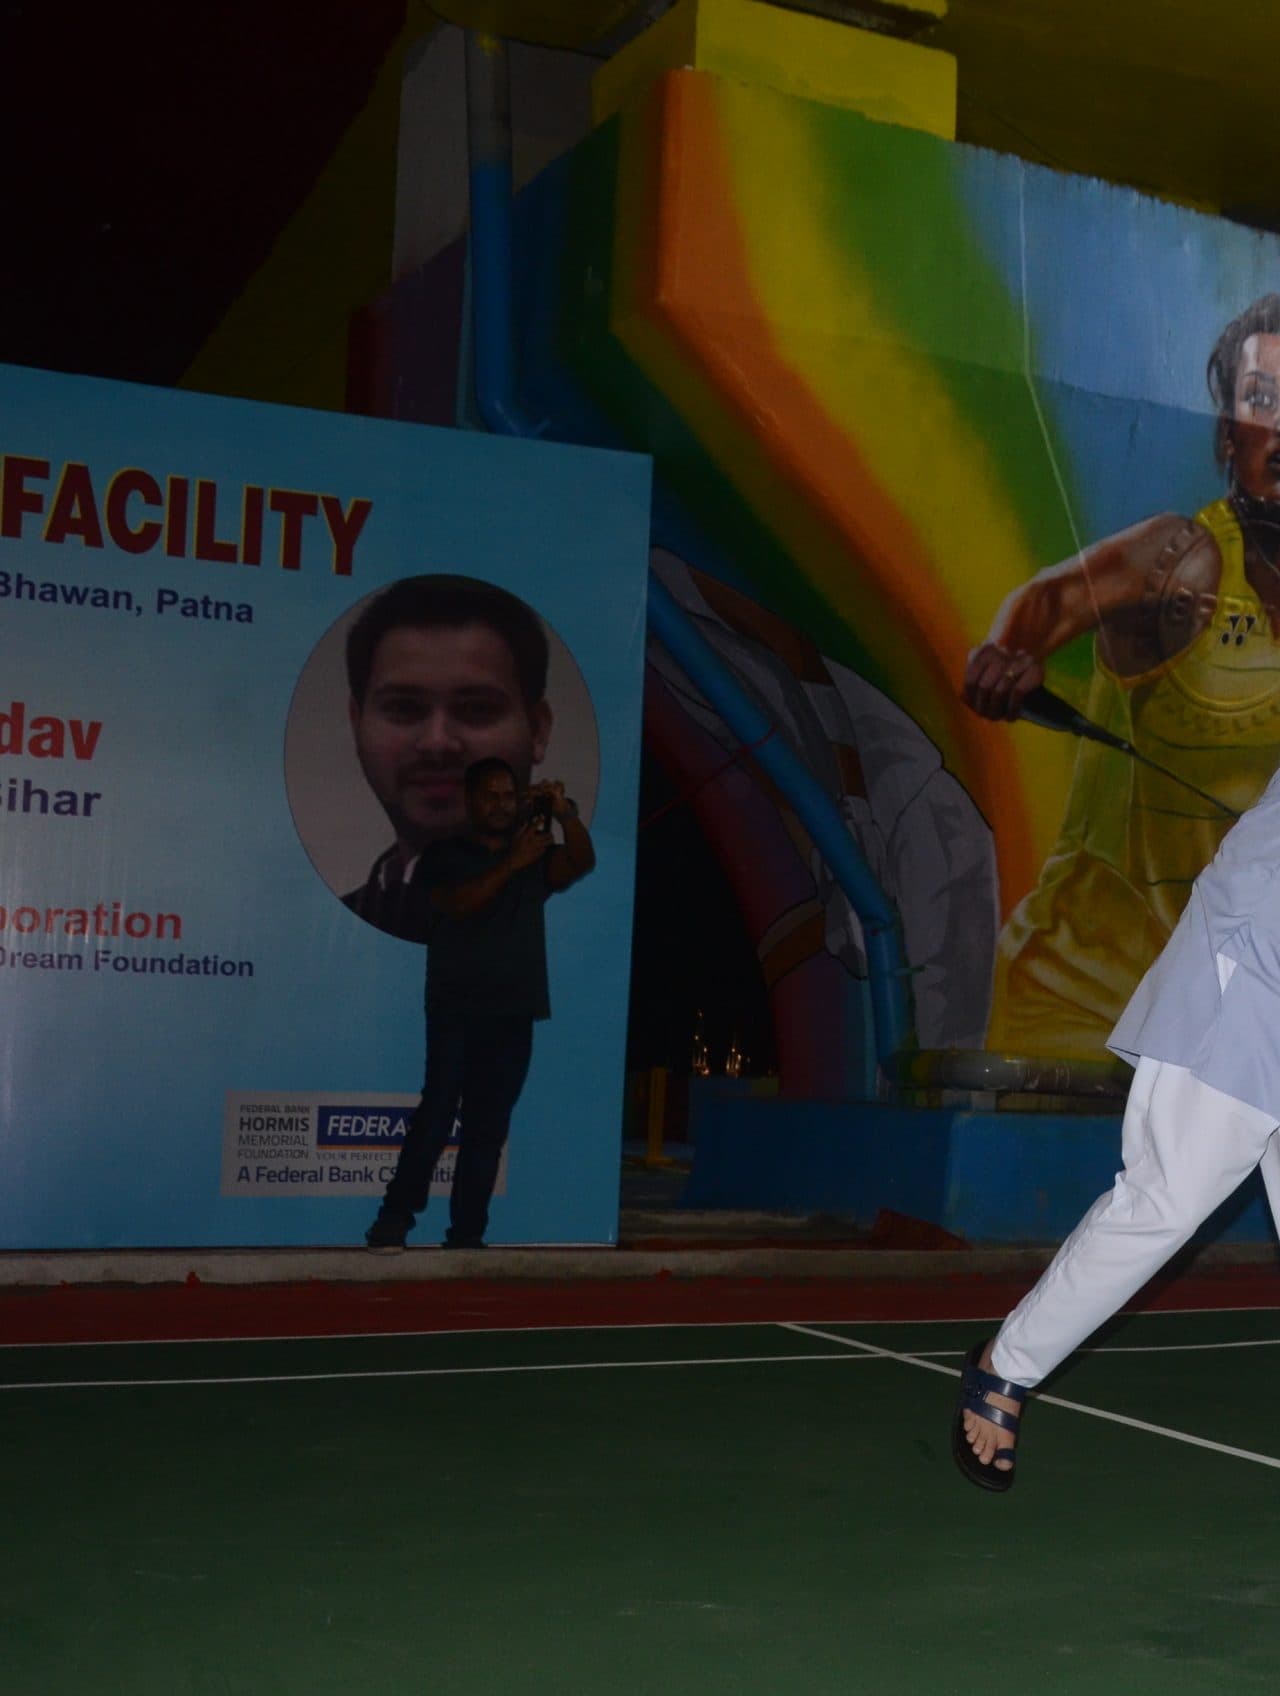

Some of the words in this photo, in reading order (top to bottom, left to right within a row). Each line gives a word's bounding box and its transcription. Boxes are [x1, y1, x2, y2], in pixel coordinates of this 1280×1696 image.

[1, 454, 373, 576] FACILITY
[156, 588, 254, 623] Patna
[0, 778, 102, 817] ihar
[95, 950, 255, 977] Foundation
[240, 1104, 281, 1113] FEDERAL
[239, 1116, 310, 1132] HORMIS
[327, 1115, 412, 1137] FEDERA
[238, 1134, 309, 1146] MEMORIAL
[238, 1148, 309, 1160] FOUNDATION
[237, 1167, 250, 1183] A
[256, 1166, 323, 1184] Federal
[329, 1166, 374, 1184] Bank
